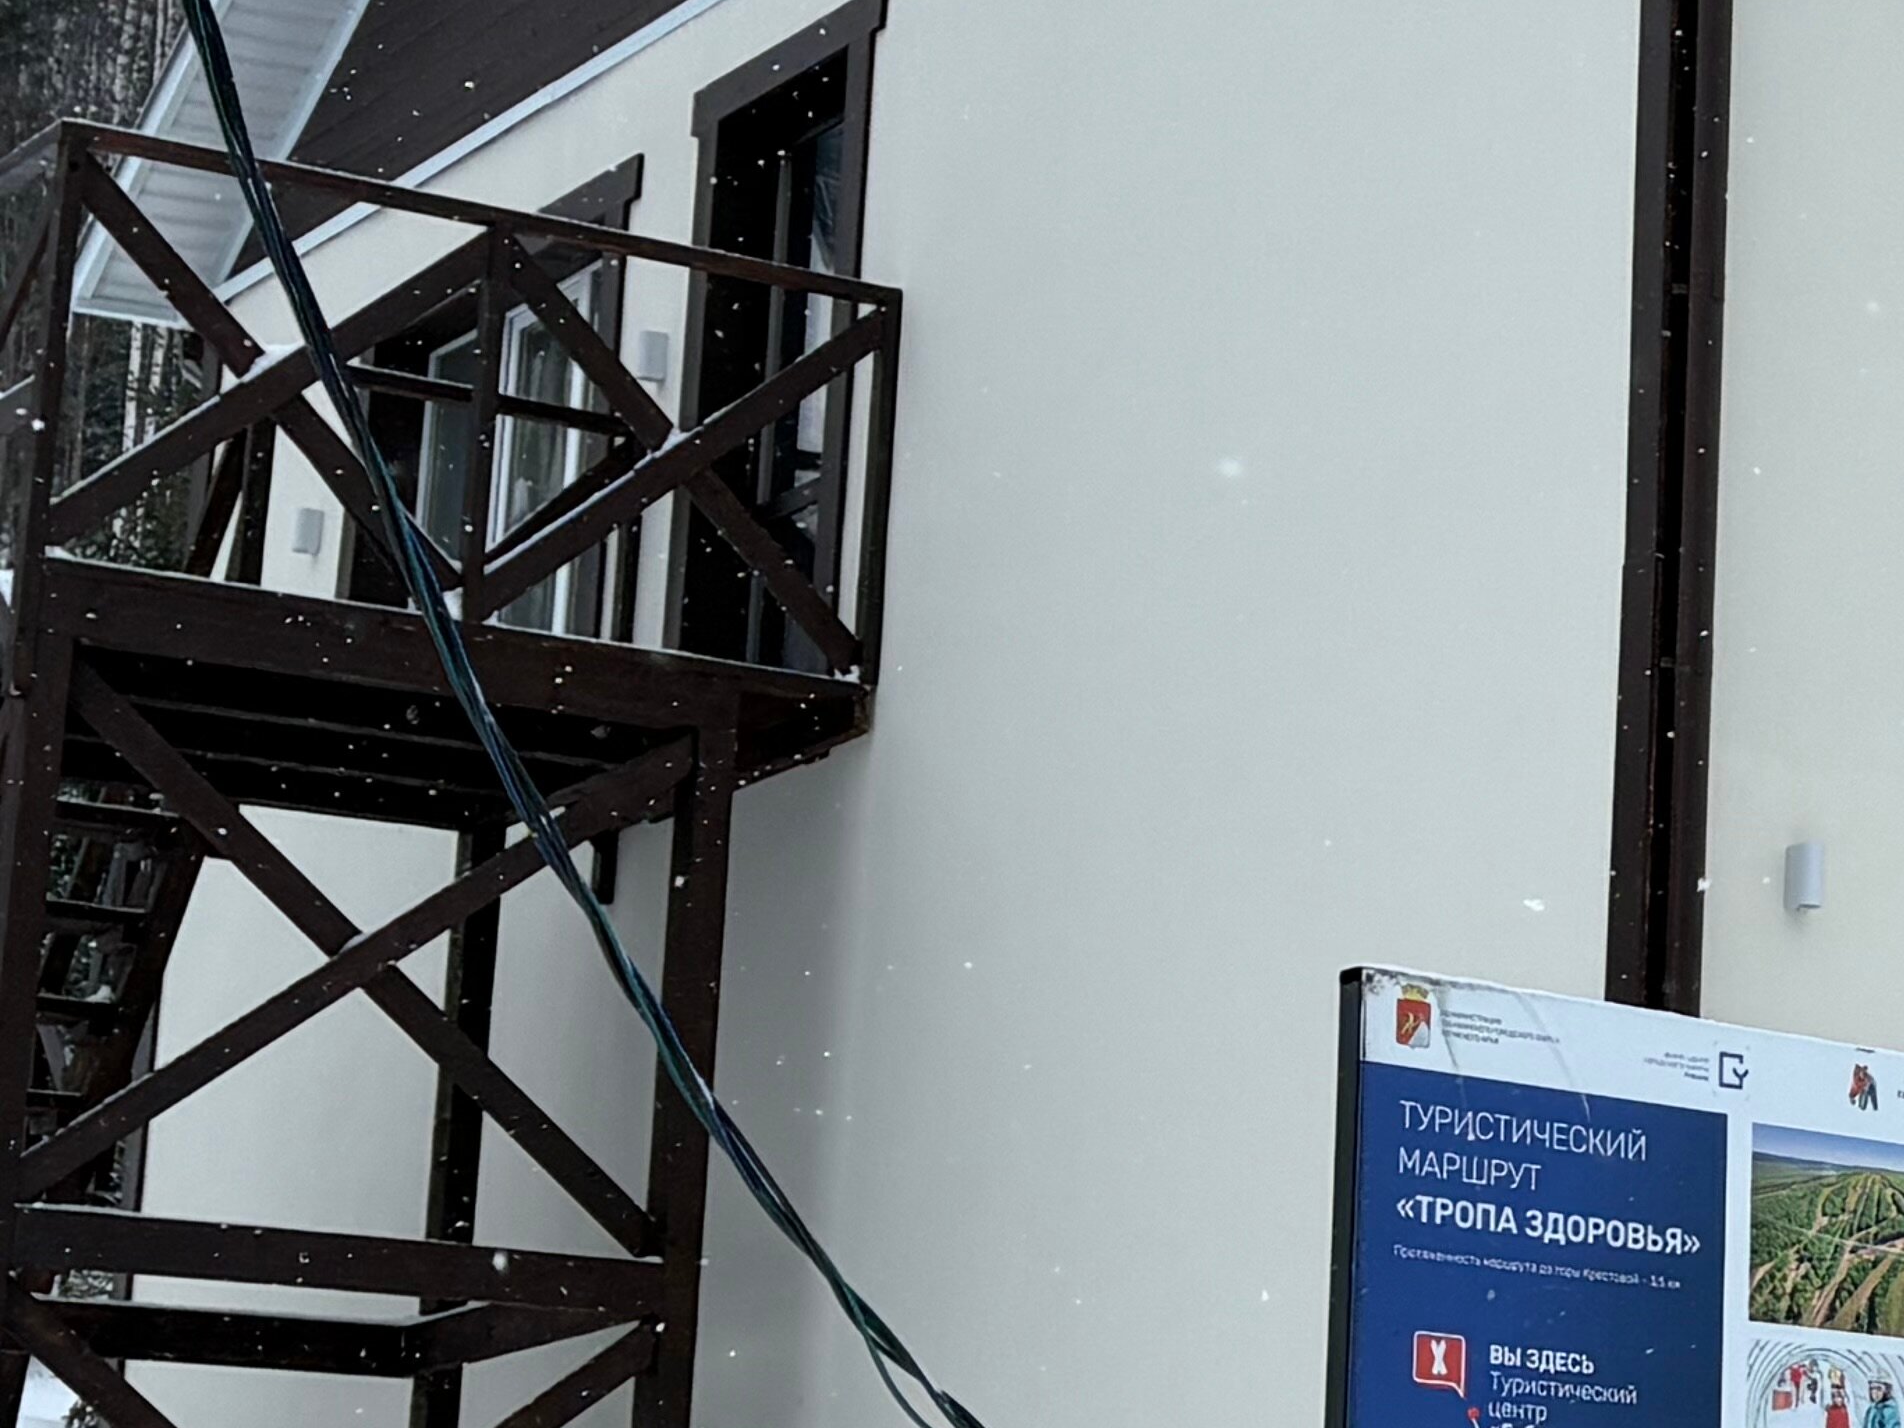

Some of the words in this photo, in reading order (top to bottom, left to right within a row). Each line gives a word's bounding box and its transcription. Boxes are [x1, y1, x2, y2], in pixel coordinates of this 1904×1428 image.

[1400, 1100, 1646, 1161] ТУРИСТИЧЕСКИЙ
[1399, 1147, 1541, 1190] МАРШРУТ
[1396, 1195, 1518, 1234] «ТРОПА
[1525, 1209, 1701, 1255] ЗДОРОВЬЯ»
[1490, 1344, 1521, 1366] ВЫ
[1526, 1348, 1594, 1374] ЗДЕСЬ
[1490, 1371, 1638, 1405] Туристический
[1488, 1401, 1547, 1424] центр
